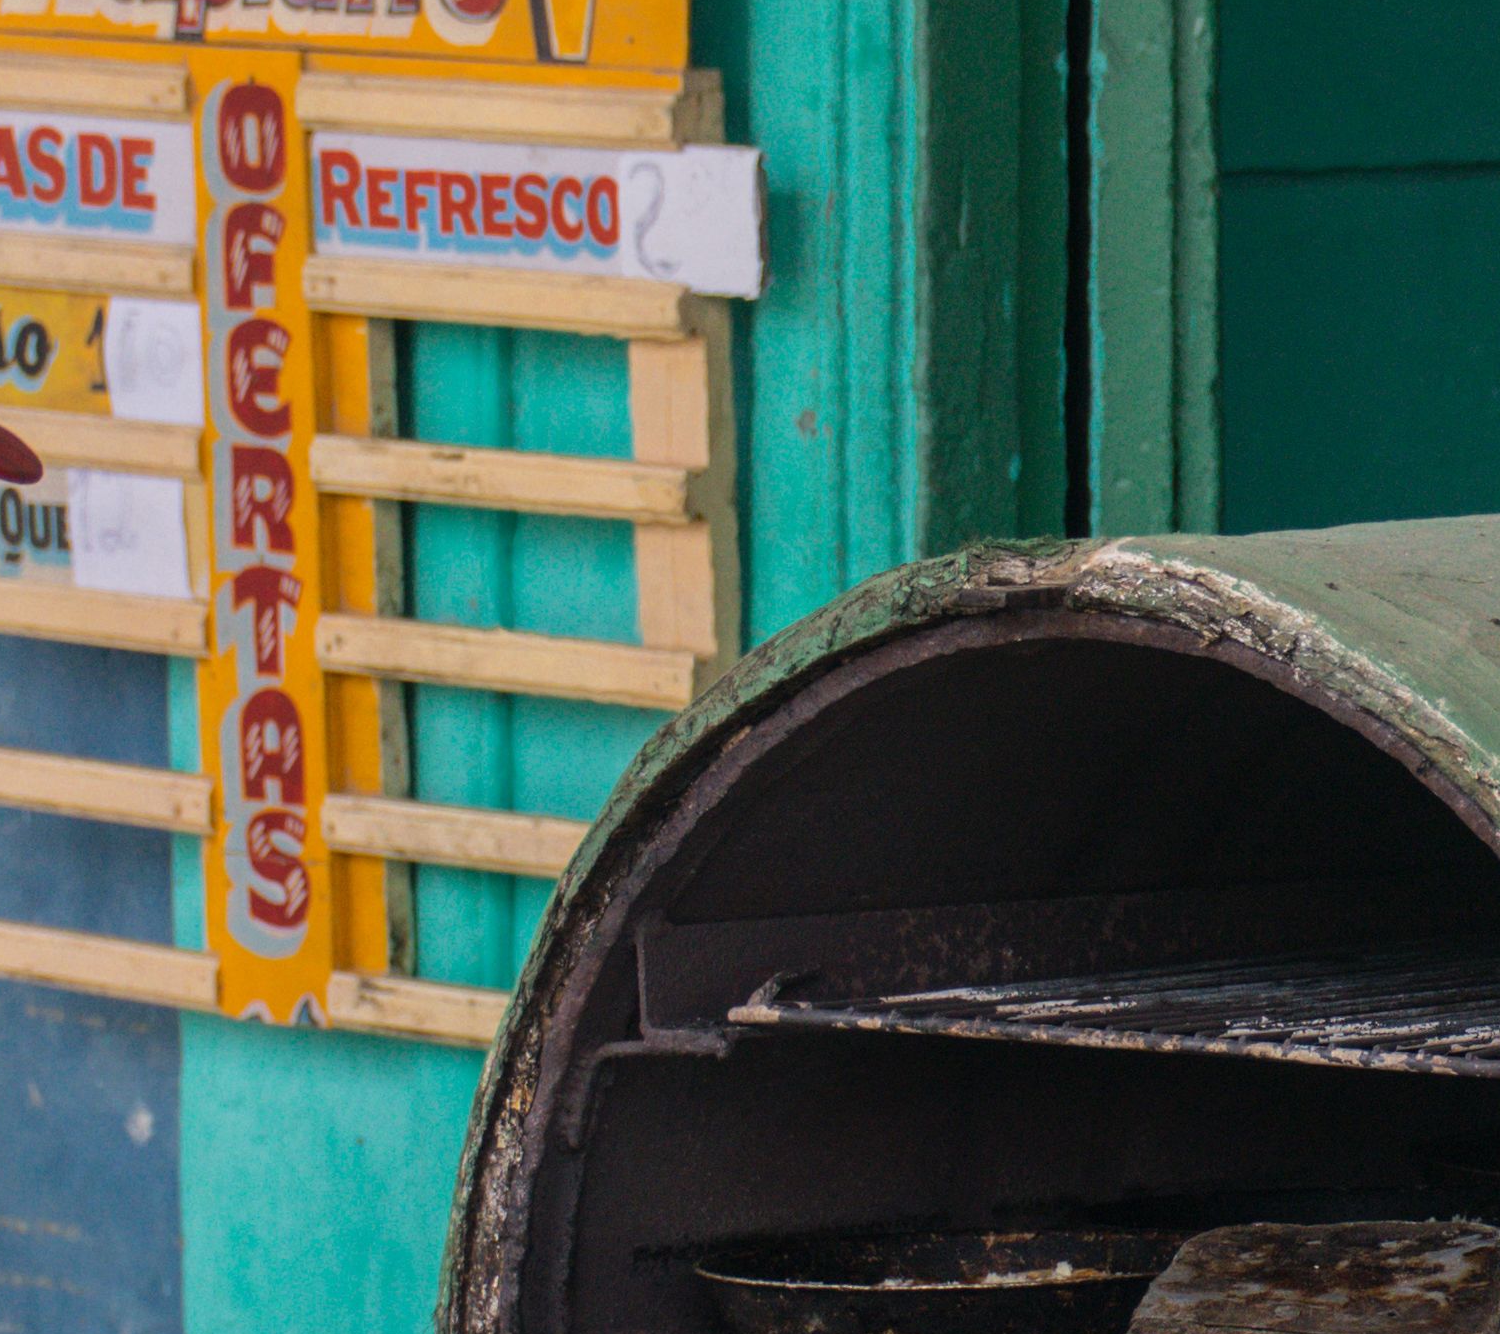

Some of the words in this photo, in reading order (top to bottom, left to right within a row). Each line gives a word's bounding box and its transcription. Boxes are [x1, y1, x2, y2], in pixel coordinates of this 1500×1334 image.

[77, 133, 158, 213] DE
[318, 148, 621, 246] REFRESCO
[218, 83, 311, 928] OFERTAS
